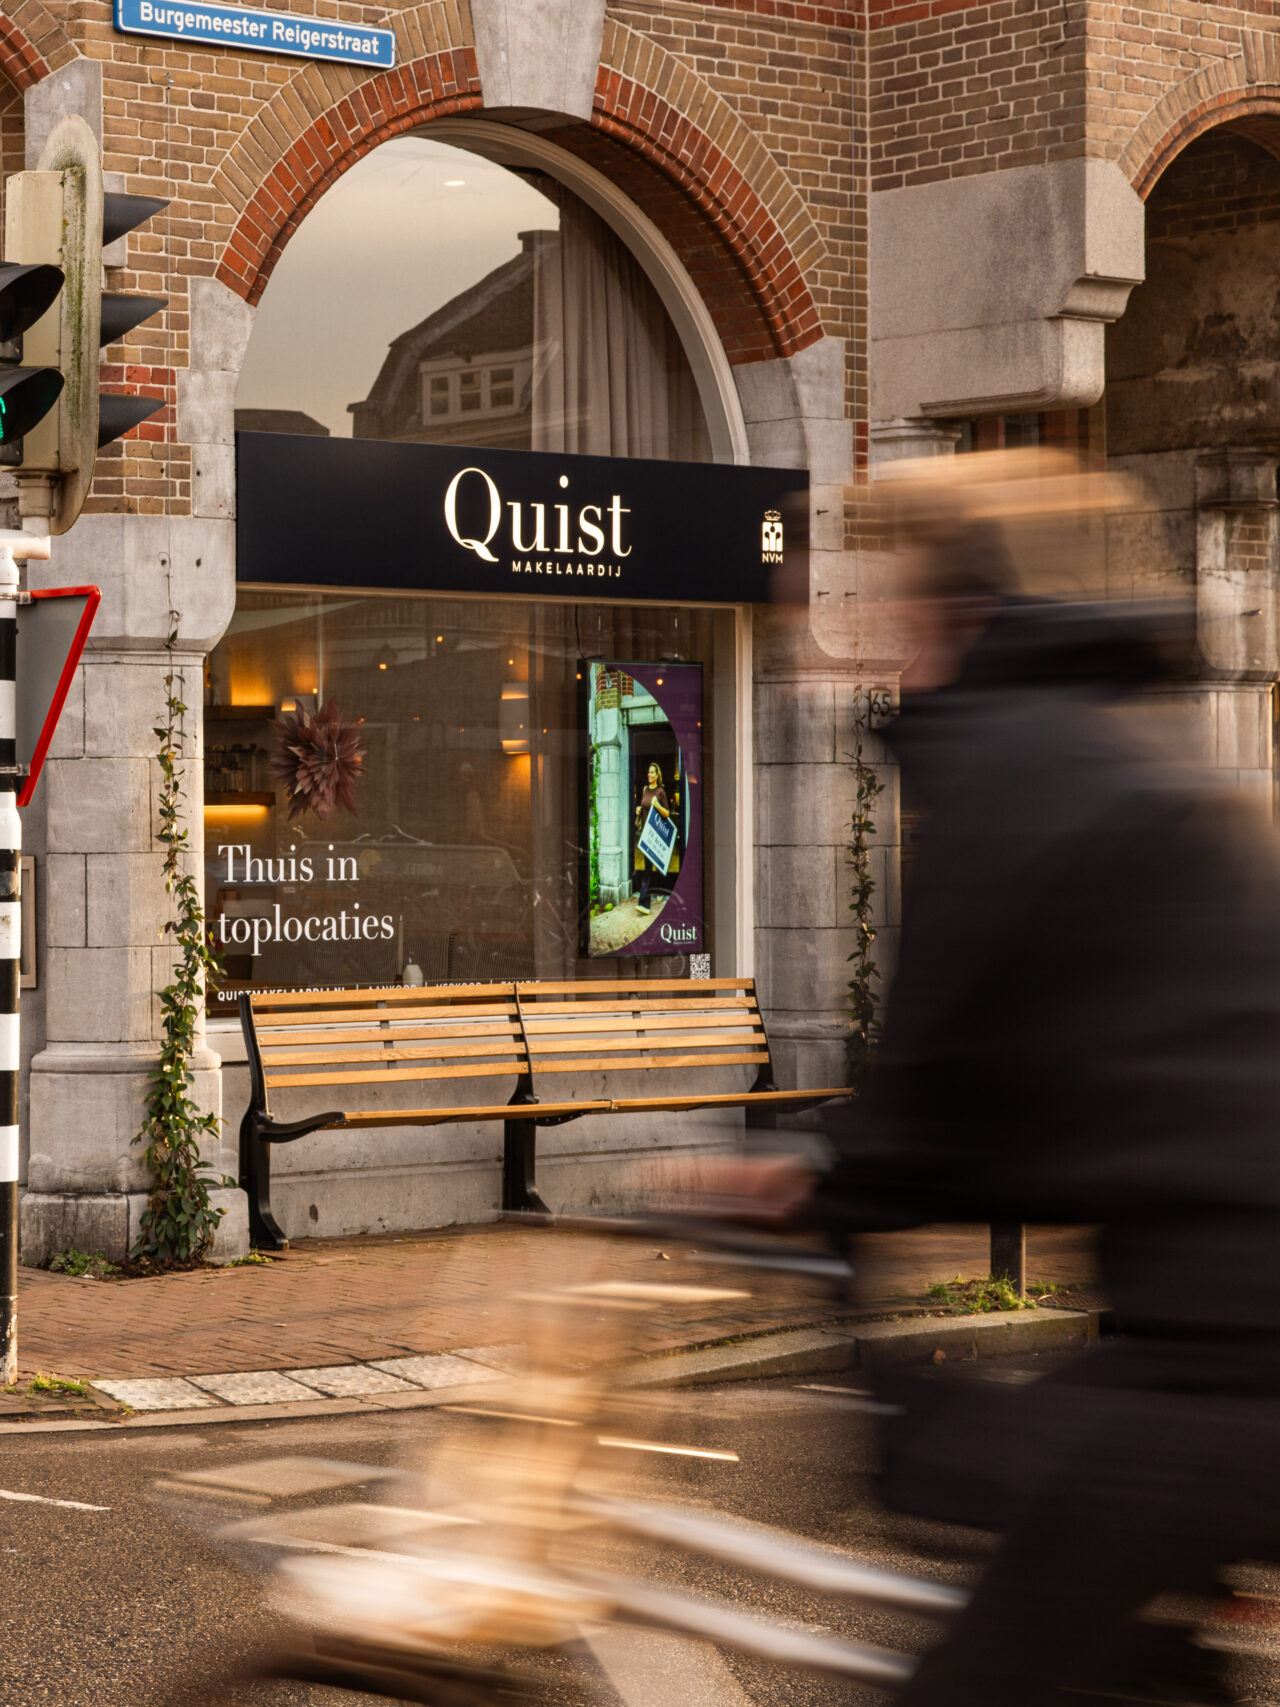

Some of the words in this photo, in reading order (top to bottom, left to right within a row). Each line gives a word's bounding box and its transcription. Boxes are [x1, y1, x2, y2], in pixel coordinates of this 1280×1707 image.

[140, 2, 267, 38] Burgemeester
[272, 21, 380, 55] Reigerstraat
[444, 467, 632, 562] Quist
[512, 560, 621, 577] MAKELAARDIJ
[762, 553, 784, 564] NVM
[871, 693, 890, 717] 65
[218, 844, 314, 883] Thuis
[326, 844, 360, 881] in
[218, 903, 395, 956] toplocaties
[660, 922, 698, 943] Quist
